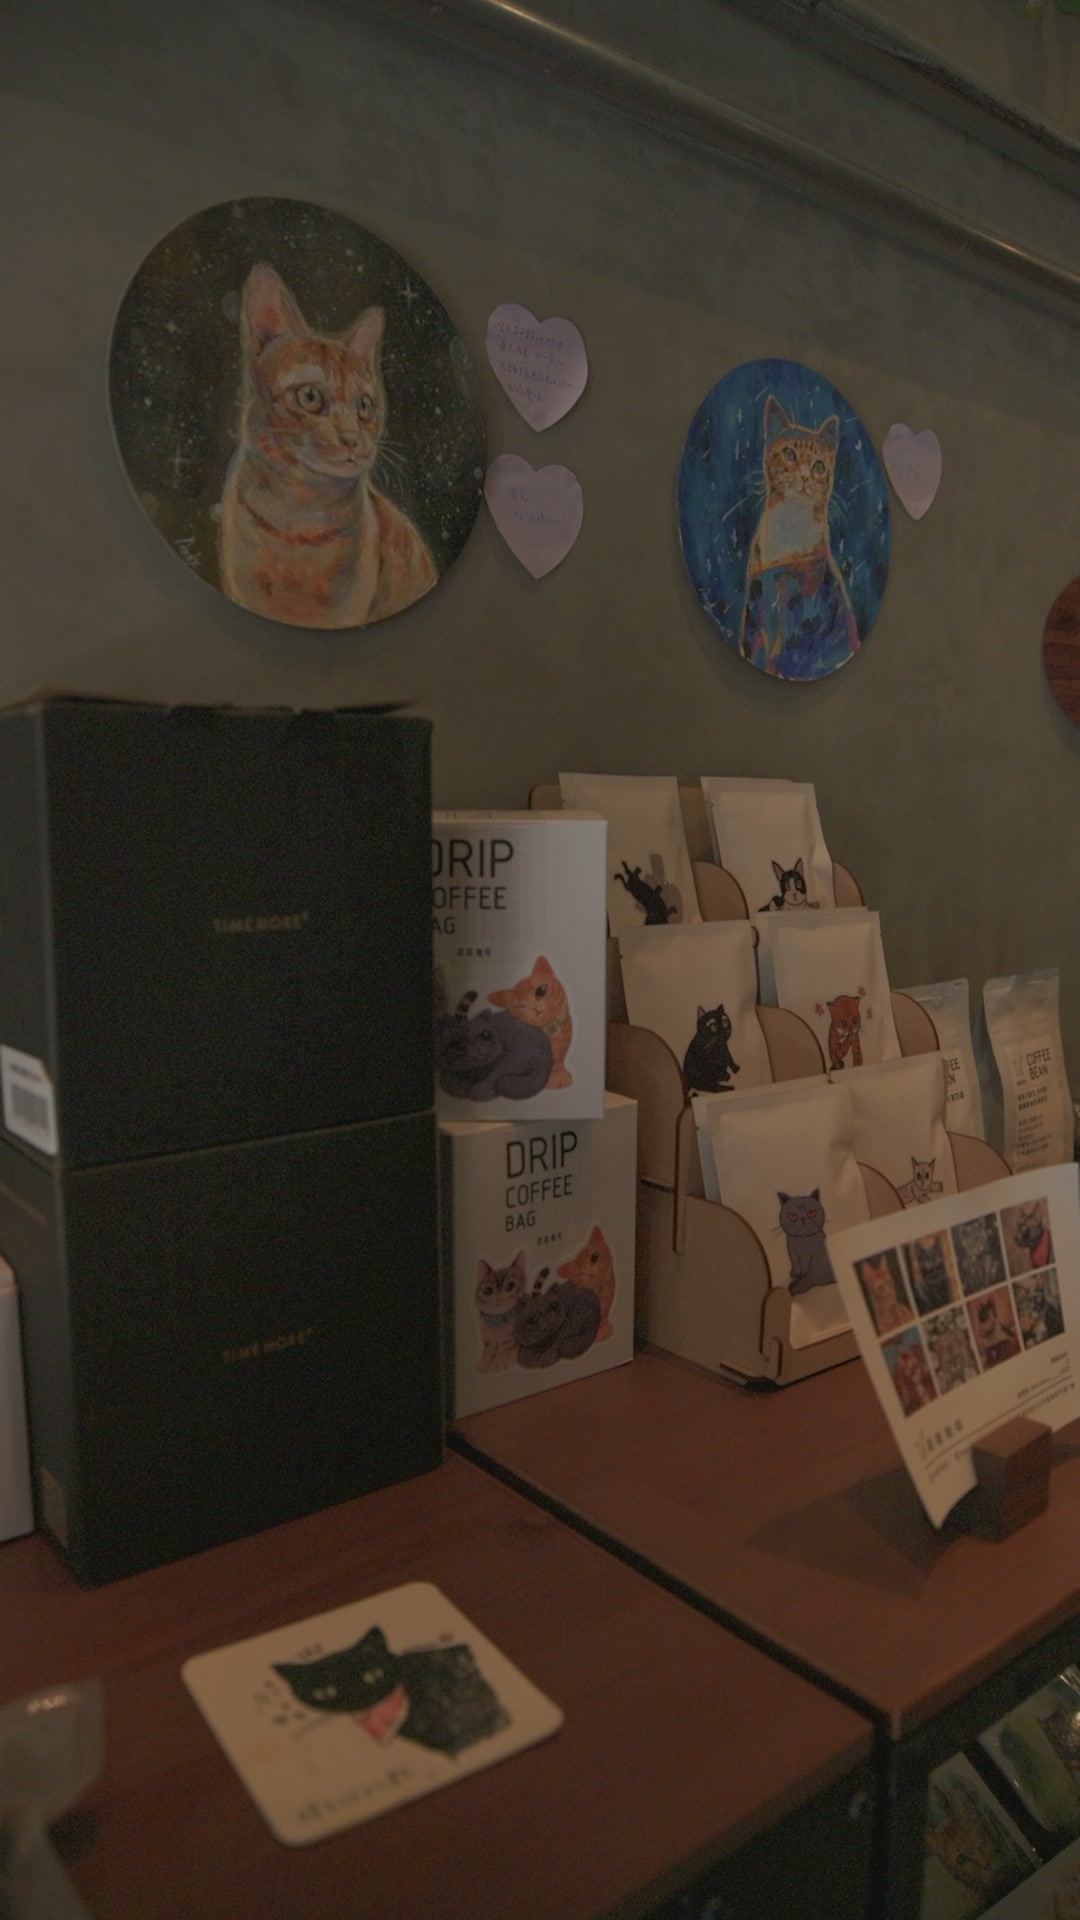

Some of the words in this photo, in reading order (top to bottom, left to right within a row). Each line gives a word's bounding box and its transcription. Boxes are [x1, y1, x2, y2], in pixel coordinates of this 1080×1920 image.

[432, 886, 507, 910] OFFEE
[506, 1131, 578, 1179] DRIP
[505, 1174, 574, 1209] COFFEE
[505, 1209, 536, 1233] BAG
